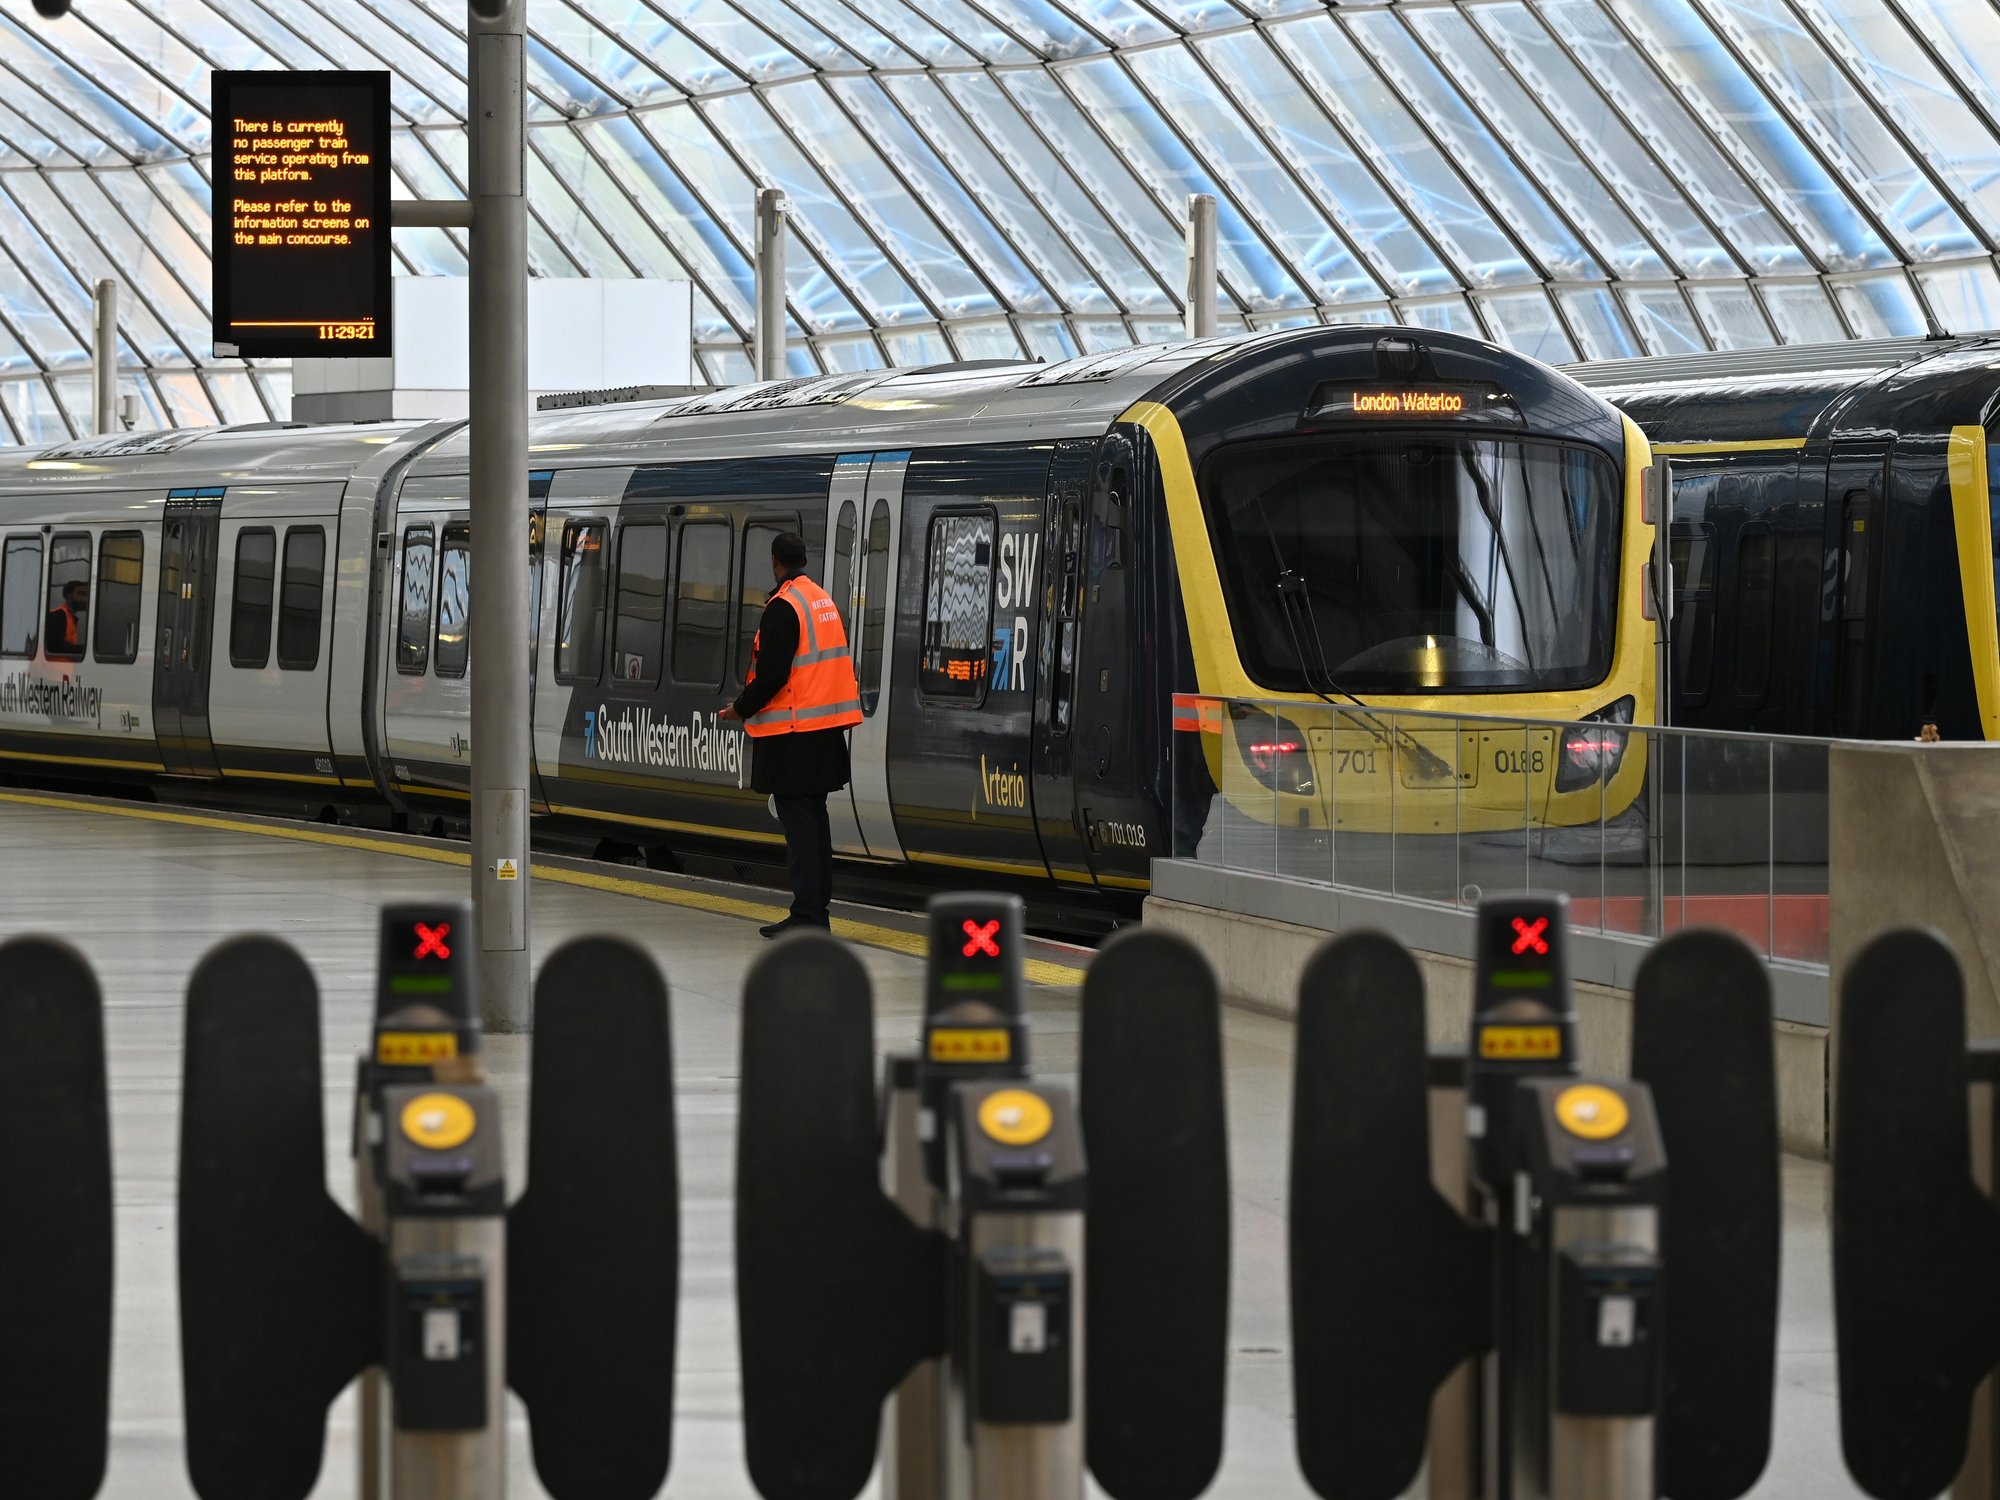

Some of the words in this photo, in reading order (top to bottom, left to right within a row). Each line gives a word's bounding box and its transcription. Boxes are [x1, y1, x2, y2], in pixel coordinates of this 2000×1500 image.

[234, 119, 268, 132] There
[272, 119, 283, 132] is
[287, 119, 344, 136] currently
[234, 138, 248, 148] no
[252, 138, 314, 152] passenger
[318, 136, 348, 148] train
[234, 152, 278, 165] service
[281, 152, 338, 168] operating
[342, 151, 369, 165] from
[234, 168, 256, 180] this
[260, 168, 313, 183] platform.
[234, 200, 271, 213] Please
[275, 200, 309, 213] refer
[313, 200, 327, 213] to
[332, 200, 351, 213] the
[234, 216, 298, 229] information
[302, 219, 350, 229] screens
[355, 219, 369, 229] on
[234, 232, 254, 245] the
[259, 232, 282, 245] main
[287, 234, 352, 245] concourse.
[319, 326, 375, 339] 11:29:21
[1353, 392, 1400, 411] London
[1402, 392, 1462, 411] Waterloo
[998, 533, 1039, 609] SW
[1011, 616, 1028, 691] R
[19, 672, 60, 716] Western
[62, 674, 103, 730] Railway
[598, 703, 635, 763] South
[636, 706, 690, 769] Western
[692, 710, 746, 790] Railway
[1336, 749, 1377, 774] 701
[1108, 821, 1127, 845] 701
[1126, 824, 1147, 848] 018
